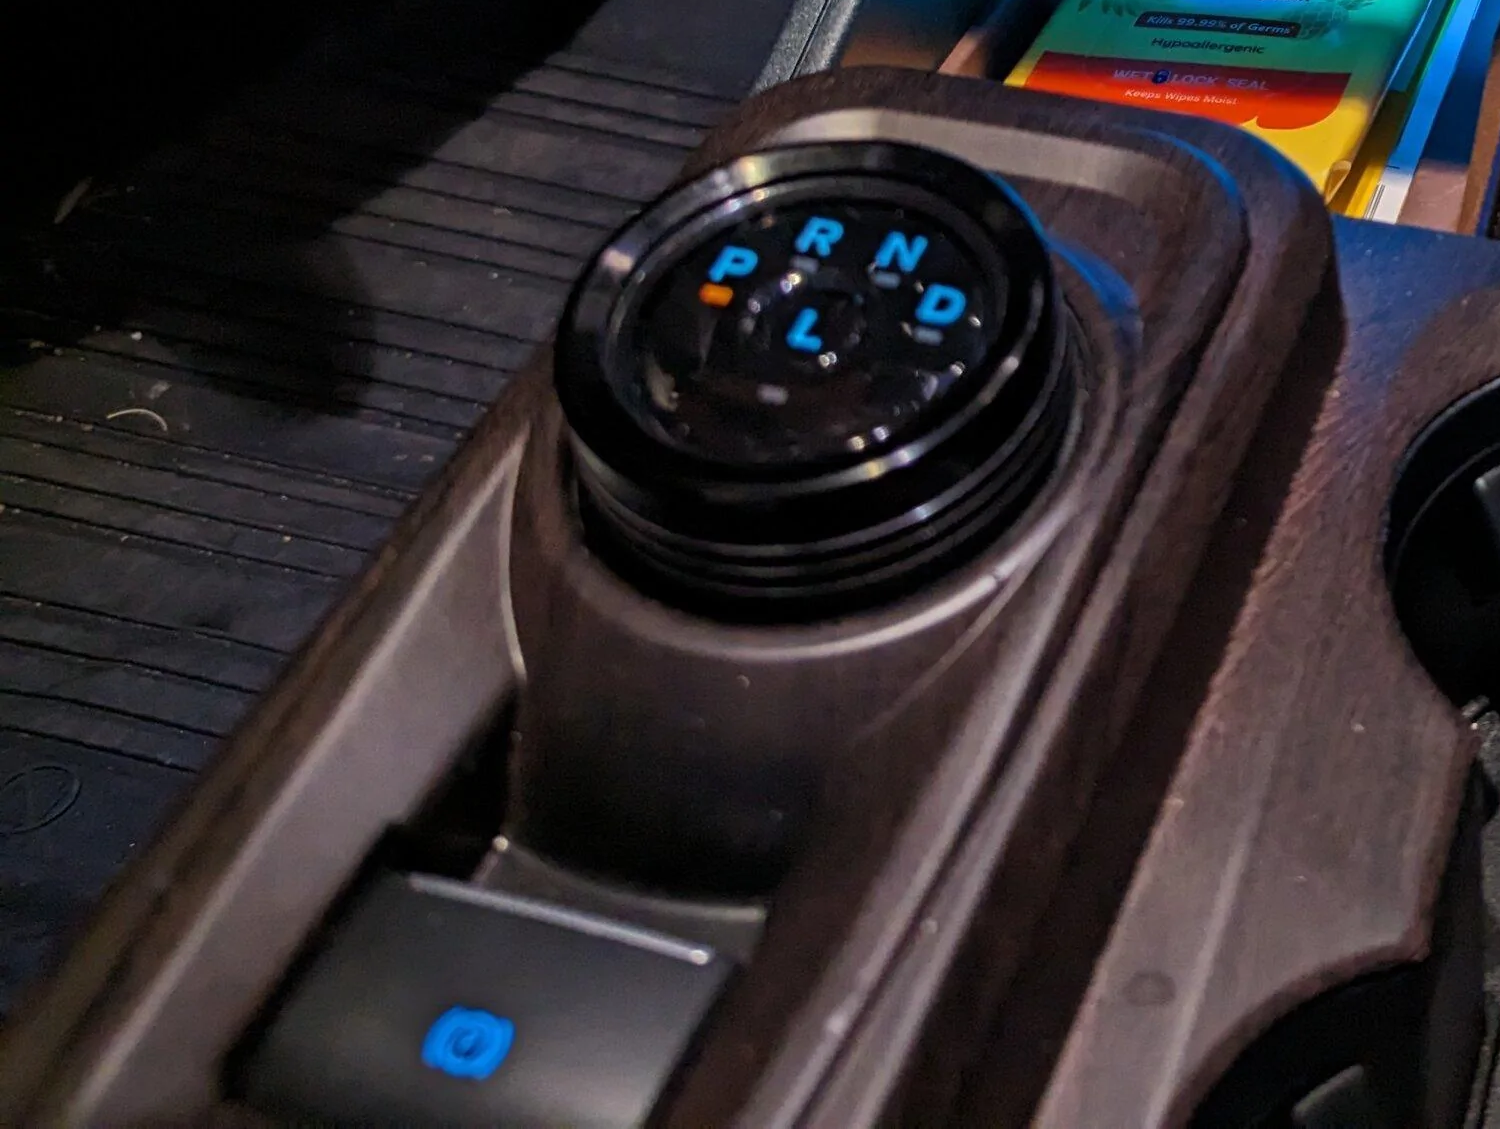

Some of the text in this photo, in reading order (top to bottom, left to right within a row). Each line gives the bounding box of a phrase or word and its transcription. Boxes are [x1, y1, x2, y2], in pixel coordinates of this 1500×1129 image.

[1147, 13, 1173, 25] Kills
[1177, 17, 1227, 29] 99.99%
[1230, 22, 1244, 31] of
[1151, 37, 1265, 54] Hypoallergenic
[1113, 70, 1268, 90] WET LOCK SEAL
[1125, 89, 1238, 105] Keeps Wipes Moist
[795, 216, 844, 256] R
[875, 231, 928, 272] N
[708, 245, 759, 282] P
[915, 283, 967, 325] D
[786, 307, 822, 352] L
